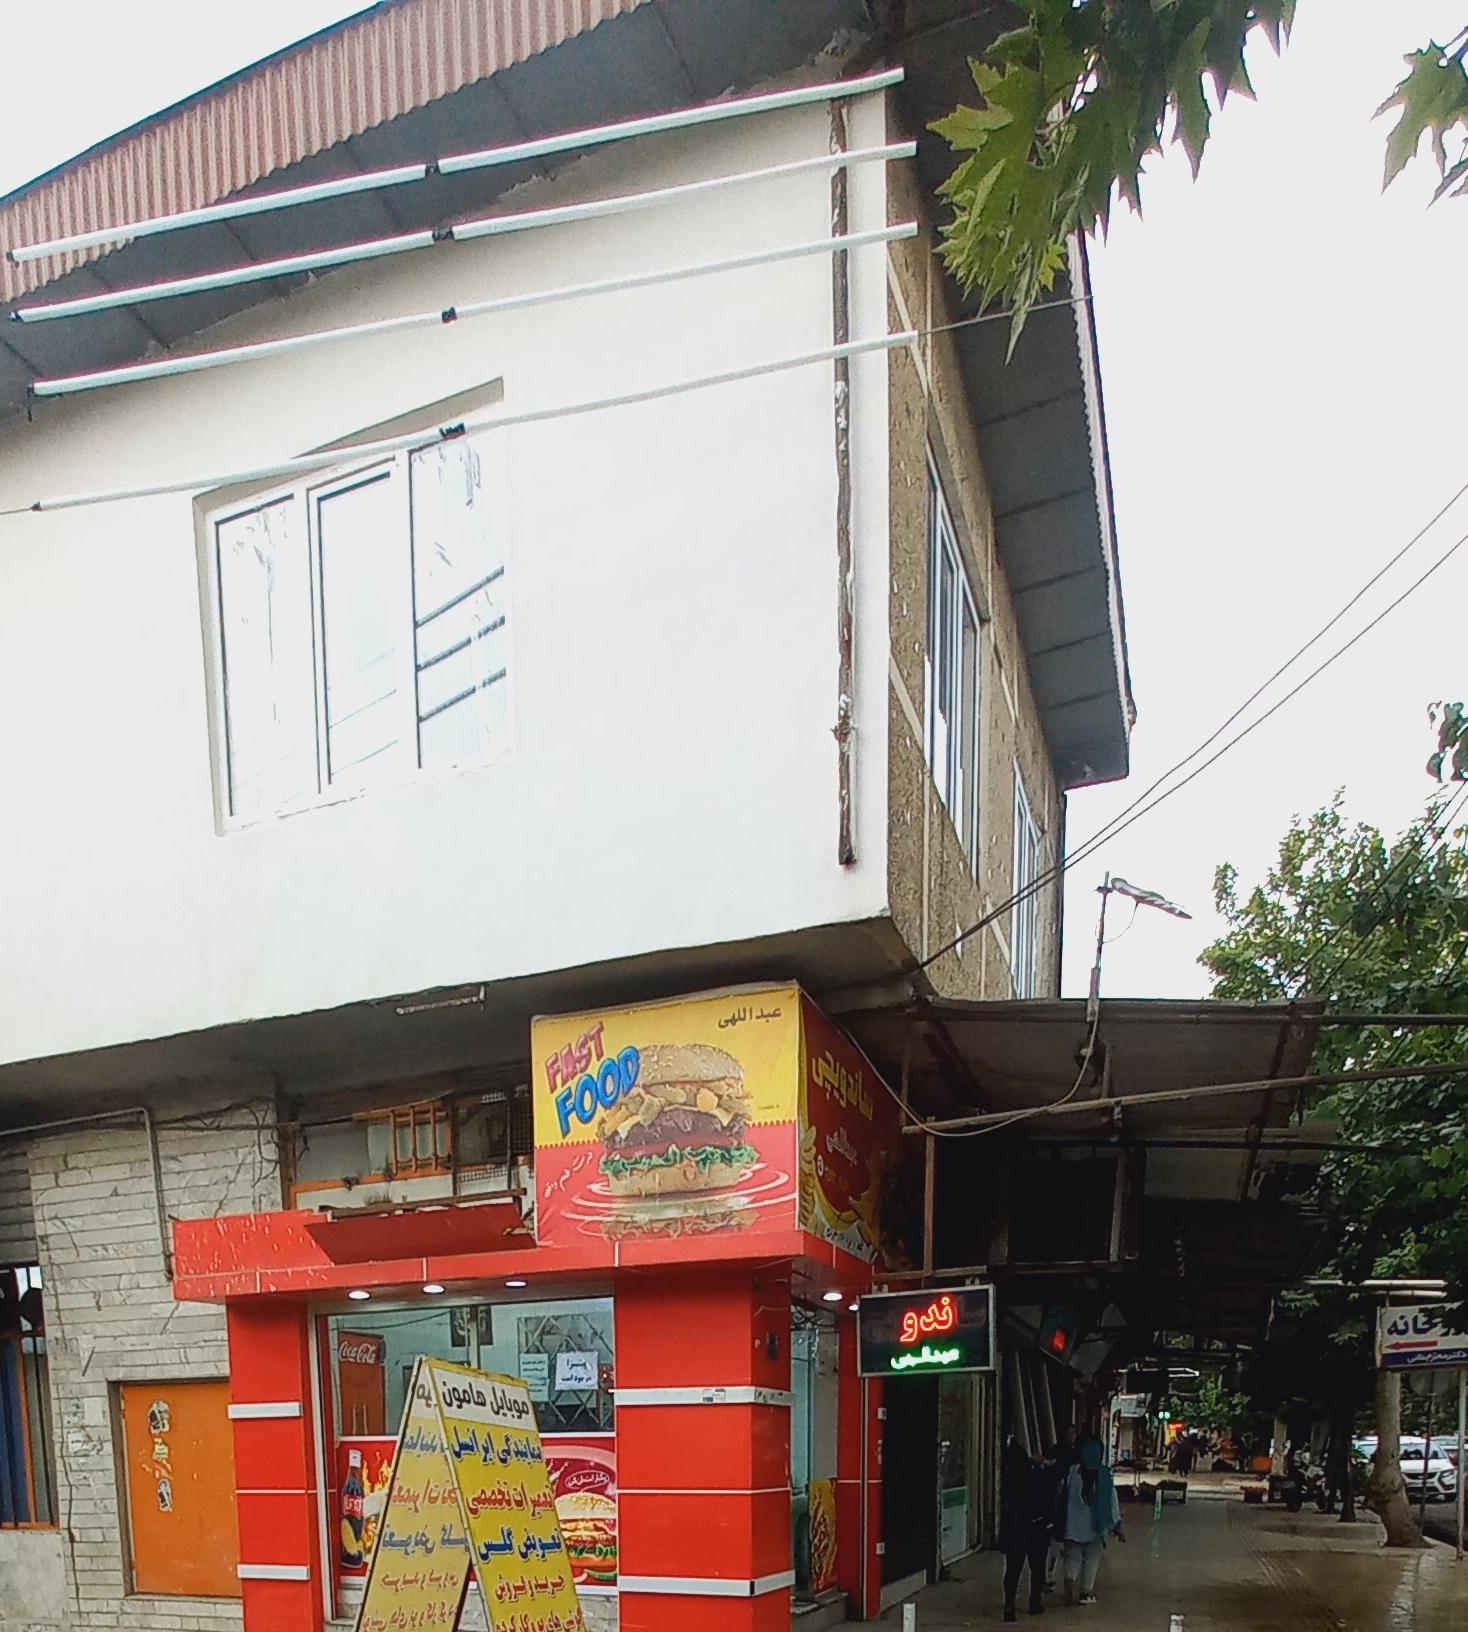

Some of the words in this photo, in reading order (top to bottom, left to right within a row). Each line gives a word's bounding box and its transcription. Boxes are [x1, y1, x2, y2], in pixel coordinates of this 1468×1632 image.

[545, 1021, 606, 1090] FAST
[555, 1045, 641, 1137] FOOD
[442, 1380, 487, 1410] هامون
[491, 1385, 530, 1419] موبایل
[478, 1527, 514, 1563] گلس
[518, 1527, 563, 1562] تعویض
